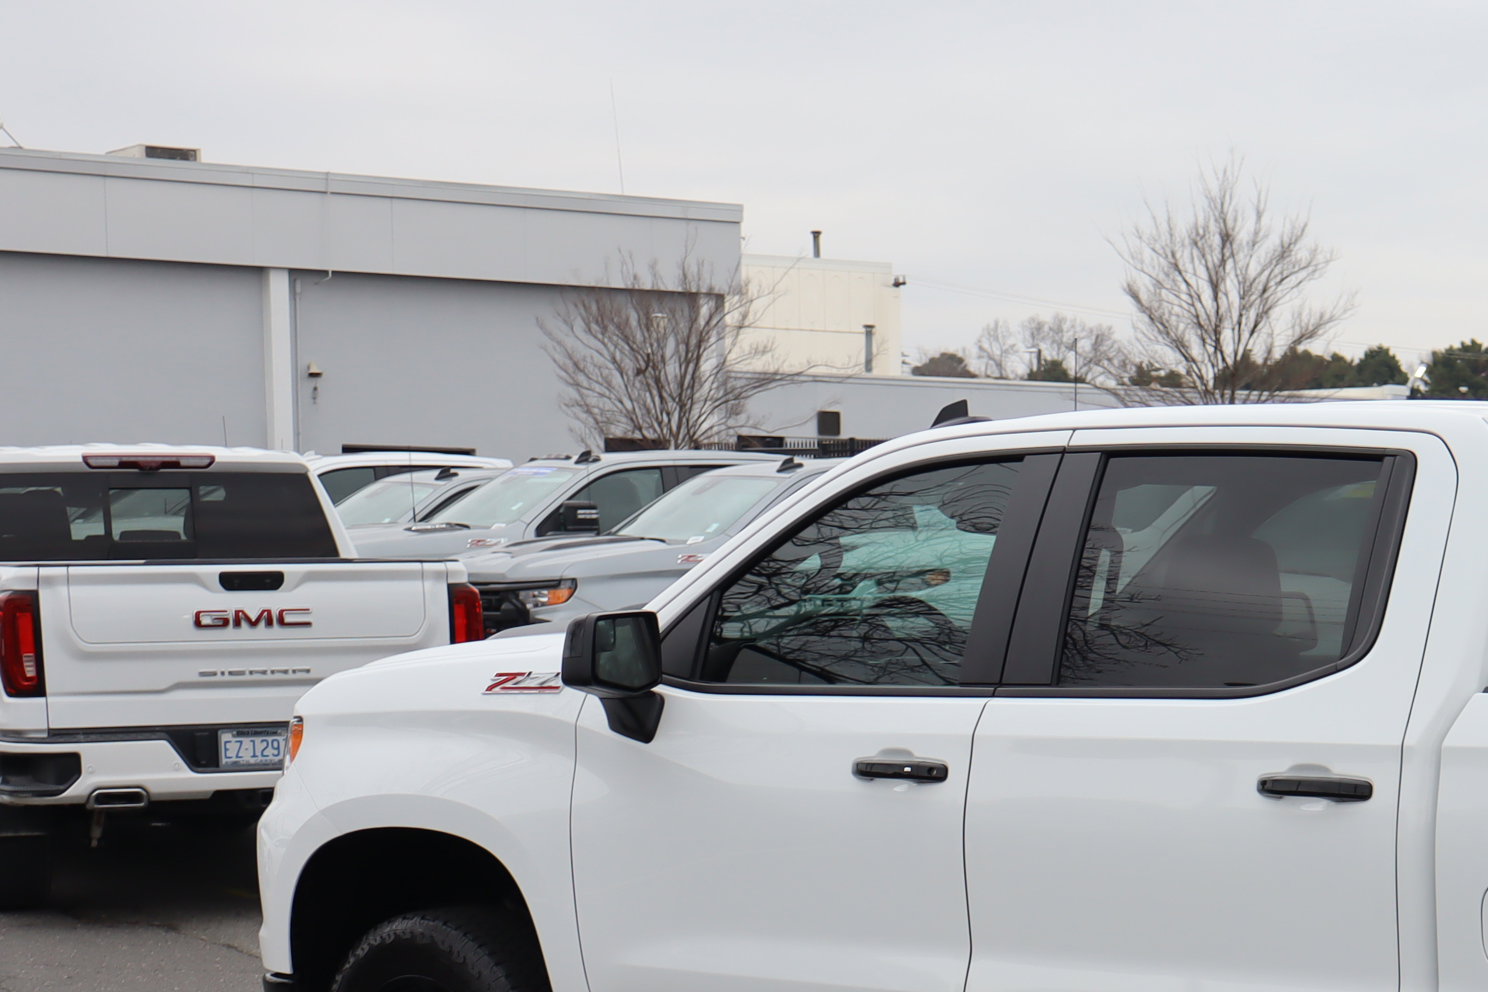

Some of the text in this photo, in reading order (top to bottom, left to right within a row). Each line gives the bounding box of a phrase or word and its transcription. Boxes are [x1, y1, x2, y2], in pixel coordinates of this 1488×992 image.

[194, 607, 313, 629] GMC
[483, 671, 562, 694] Z7
[223, 737, 287, 759] EZ-129
